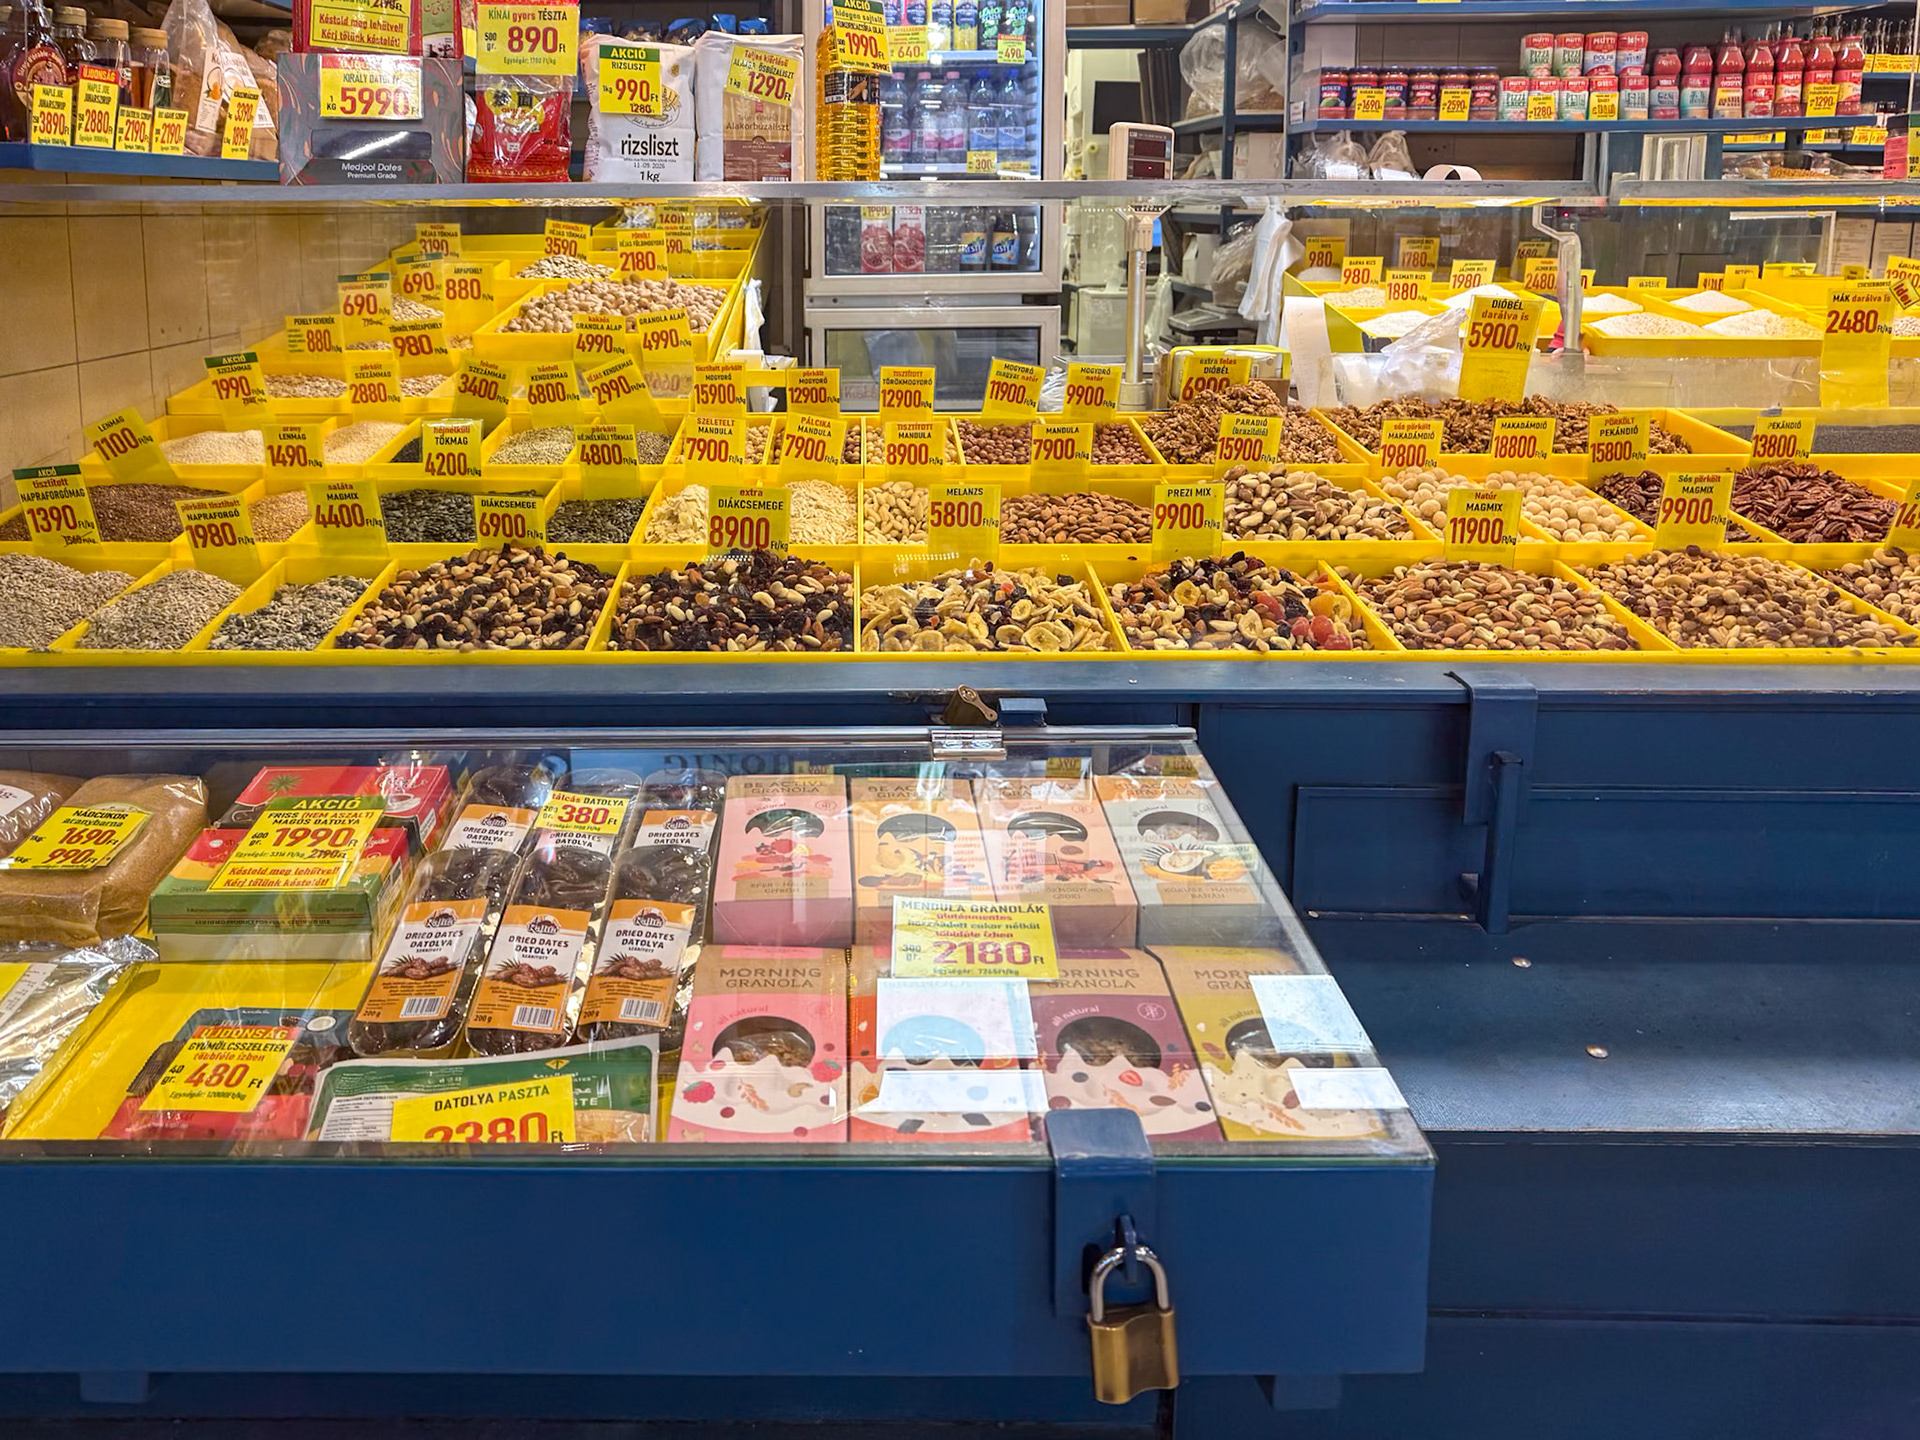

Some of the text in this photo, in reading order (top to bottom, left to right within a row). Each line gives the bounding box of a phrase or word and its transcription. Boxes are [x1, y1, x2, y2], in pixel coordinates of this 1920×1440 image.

[538, 9, 568, 20] TÉSZTA
[508, 26, 558, 54] 890
[845, 32, 878, 59] 1990
[610, 47, 646, 60] AKCIÓ
[898, 46, 920, 58] 640
[1004, 48, 1022, 58] 490
[612, 62, 646, 72] RIZSLISZT
[616, 78, 650, 101] 990
[748, 72, 787, 100] 1290
[340, 87, 410, 116] 5990
[1362, 100, 1380, 110] 1690
[1446, 100, 1465, 110] 2590
[1814, 95, 1833, 107] 1290
[1533, 106, 1552, 116] 1280
[39, 110, 65, 135] 3890
[84, 109, 110, 134] 2880
[160, 120, 181, 144] 2190
[621, 134, 680, 156] rizsliszt
[544, 236, 578, 258] 3590
[620, 250, 656, 272] 2180
[1309, 251, 1333, 268] 980
[403, 271, 435, 294] 690
[1343, 268, 1371, 285] 980
[1452, 273, 1482, 290] 1980
[1526, 272, 1556, 290] 2480
[446, 278, 481, 300] 880
[1387, 282, 1418, 301] 1880
[1832, 292, 1882, 303] MÁK darálva
[342, 293, 378, 316] 690
[1491, 298, 1524, 312] DIÓBÉL
[639, 312, 686, 326] GRANOLA ALAP
[1482, 310, 1516, 320] darálva
[1826, 308, 1879, 334] 2480
[576, 322, 622, 332] GRANOLA ALAP
[306, 328, 332, 352] 880
[576, 334, 613, 354] 4990
[642, 328, 680, 351] 4990
[1468, 323, 1519, 350] 5900
[393, 334, 434, 358] 980
[530, 372, 568, 382] KENDERMAG
[706, 373, 732, 382] MOGYORÓ
[1003, 363, 1034, 375] MOGYORÓ
[1080, 366, 1112, 376] MOGYORÓ
[212, 376, 252, 400] 1990
[458, 374, 498, 401] 3400
[798, 376, 828, 385] MOGYORÓ
[350, 382, 388, 404] 2880
[527, 382, 566, 405] 6800
[591, 375, 632, 406] 2990
[694, 383, 736, 405] 15900
[788, 387, 828, 405] 12900
[880, 388, 922, 408] 12900
[990, 380, 1026, 405] 11900
[1066, 384, 1104, 407] 9900
[98, 416, 124, 432] LENMAG
[696, 418, 736, 427] SZELETELT
[698, 426, 733, 436] MANDULA
[1046, 426, 1080, 434] MANDULA
[1767, 420, 1802, 430] PEKÁNDIÓ
[278, 432, 306, 441] LENMAG
[796, 425, 832, 438] MANDULA
[898, 431, 932, 440] MANDULA
[1388, 430, 1436, 440] MAKADÁMDIÓ
[1600, 426, 1639, 438] PEKÁNDIÓ
[94, 427, 138, 462] 1100
[686, 438, 729, 463] 7900
[785, 434, 826, 463] 7900
[1032, 438, 1076, 460] 7900
[1218, 436, 1262, 462] 15900
[1494, 435, 1536, 459] 18800
[1590, 440, 1632, 464] 15800
[1752, 434, 1797, 458] 13800
[267, 444, 308, 468] 1490
[580, 444, 622, 466] 4800
[886, 444, 929, 466] 8900
[1381, 444, 1426, 468] 19800
[425, 452, 467, 476] 4200
[1694, 474, 1722, 484] pörkölt
[20, 487, 86, 502] NAPRAFORGÓMAG
[326, 492, 359, 502] MAGMIX
[739, 488, 764, 497] extra
[946, 488, 984, 496] MELANZS
[1167, 488, 1212, 498] PREZI MIX
[1682, 484, 1714, 494] MAGMIX
[480, 498, 536, 510] DIÁKCSEMEGE
[718, 498, 784, 510] DIÁKCSEMEGE
[1466, 502, 1504, 512] MAGMIX
[1660, 497, 1727, 526] 9900 Ft/kg
[27, 504, 78, 534] 1390
[186, 508, 240, 521] NAPRAFORGÓ
[315, 503, 365, 529] 4400
[930, 500, 983, 528] 5800
[1155, 503, 1220, 530] 9900 Ft/kg
[479, 512, 526, 539] 6900
[710, 515, 770, 550] 8900
[1450, 517, 1504, 545] 11900
[185, 522, 238, 548] 1980
[751, 786, 820, 794] GRANOLA
[293, 797, 362, 810] AKCIÓ
[583, 797, 624, 808] DATOLYA
[72, 808, 129, 820] NÁDCUKOR
[558, 804, 610, 826] 380
[58, 828, 117, 846] 1690
[272, 827, 356, 848] 1990
[466, 834, 504, 844] DATOLYA
[648, 831, 672, 840] DRIED
[654, 837, 692, 845] DATOLYA
[42, 848, 96, 865] 990
[902, 900, 1046, 914] MENDULA GRANOLÁK
[405, 930, 464, 940] DRIED DATES
[410, 938, 453, 948] DATOLYA
[508, 935, 570, 948] DRIED DATES
[616, 929, 675, 941] DRIED DATES
[620, 938, 665, 949] DATOLYA
[514, 946, 559, 956] DATOLYA
[932, 941, 1045, 966] 2180 Ft
[720, 968, 822, 978] MORNING
[726, 978, 814, 988] GRANOLA
[1063, 1006, 1100, 1019] natural
[200, 1027, 288, 1040] ÚJDONSÁG
[188, 1042, 288, 1052] GYÜMÖLCSSZELETEK
[237, 1052, 265, 1062] ízben
[169, 1064, 184, 1074] 40
[185, 1063, 264, 1088] 480 Ft
[434, 1084, 550, 1112] DATOLYA PASZTA
